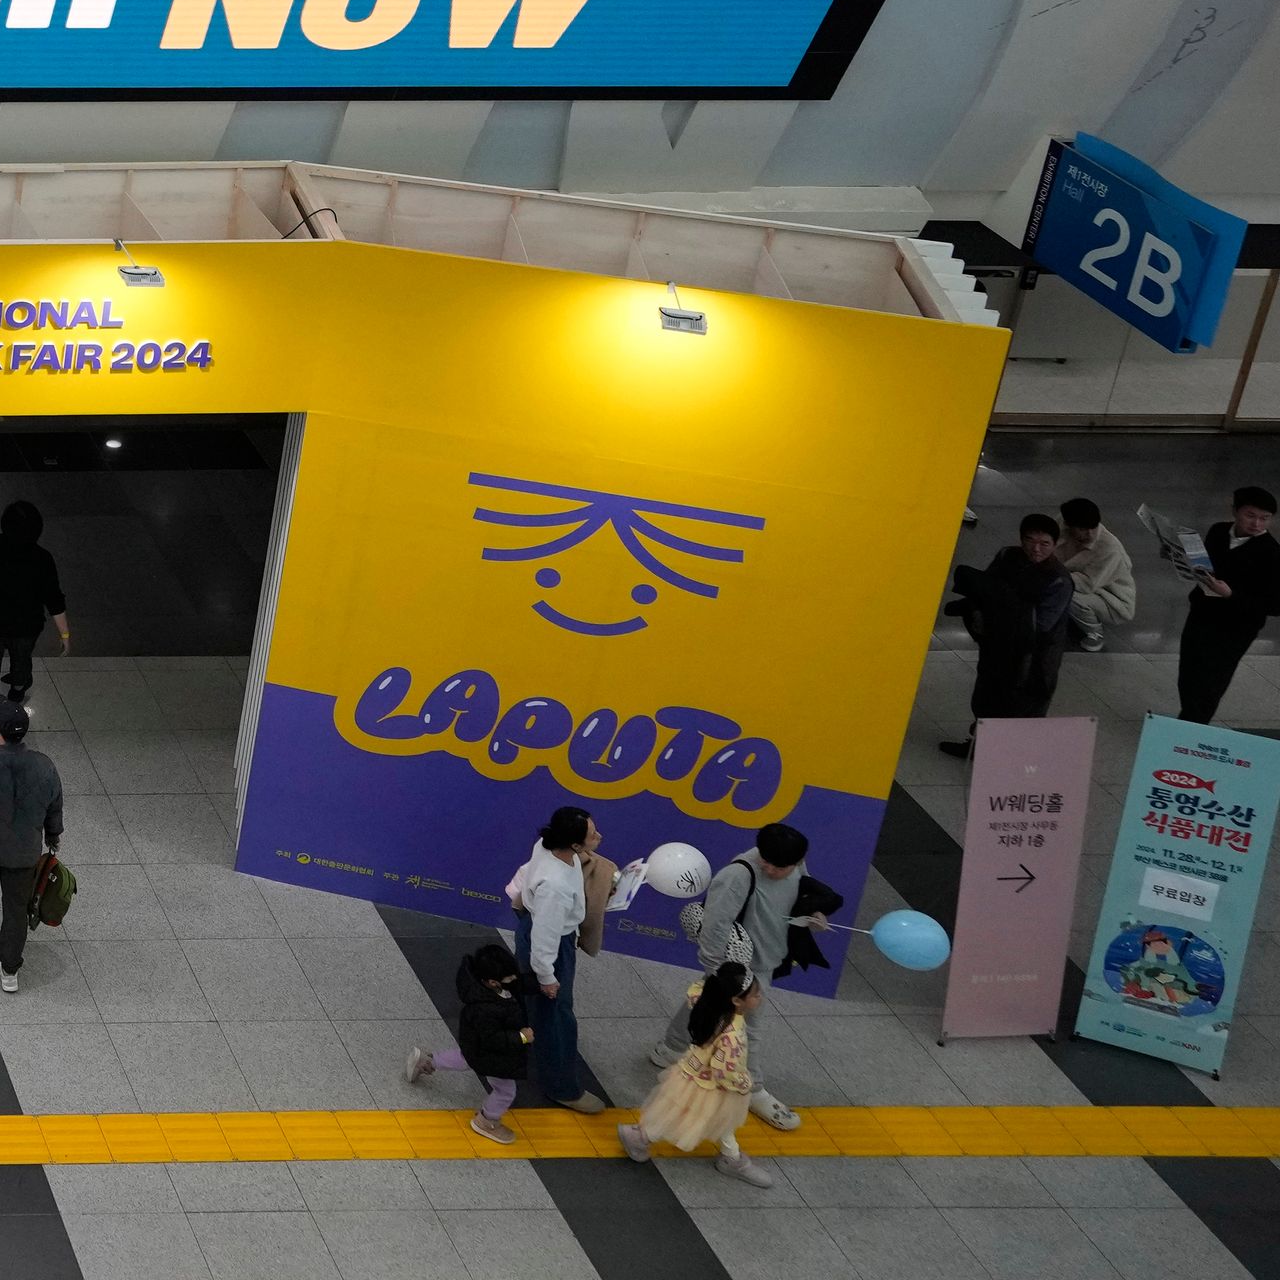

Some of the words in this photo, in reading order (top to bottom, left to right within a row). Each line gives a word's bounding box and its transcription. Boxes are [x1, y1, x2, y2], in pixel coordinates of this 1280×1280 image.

[1038, 155, 1058, 205] EXHIBITION
[1063, 182, 1086, 202] Hall
[1030, 204, 1043, 239] CENTER
[1079, 207, 1182, 318] 2B
[11, 344, 102, 370] FAIR
[112, 342, 210, 369] 2024
[354, 666, 783, 812] LAPUTA
[1160, 771, 1198, 787] 2024
[989, 792, 1064, 814] W웨딩홀
[1145, 786, 1257, 828] 통영수산
[998, 834, 1024, 848] 지하
[1142, 810, 1253, 854] 식품대전
[1134, 855, 1151, 865] 부산
[276, 849, 291, 859] 주최
[383, 871, 400, 881] 주관
[461, 887, 502, 904] bexco
[1151, 884, 1207, 908] 무료입장
